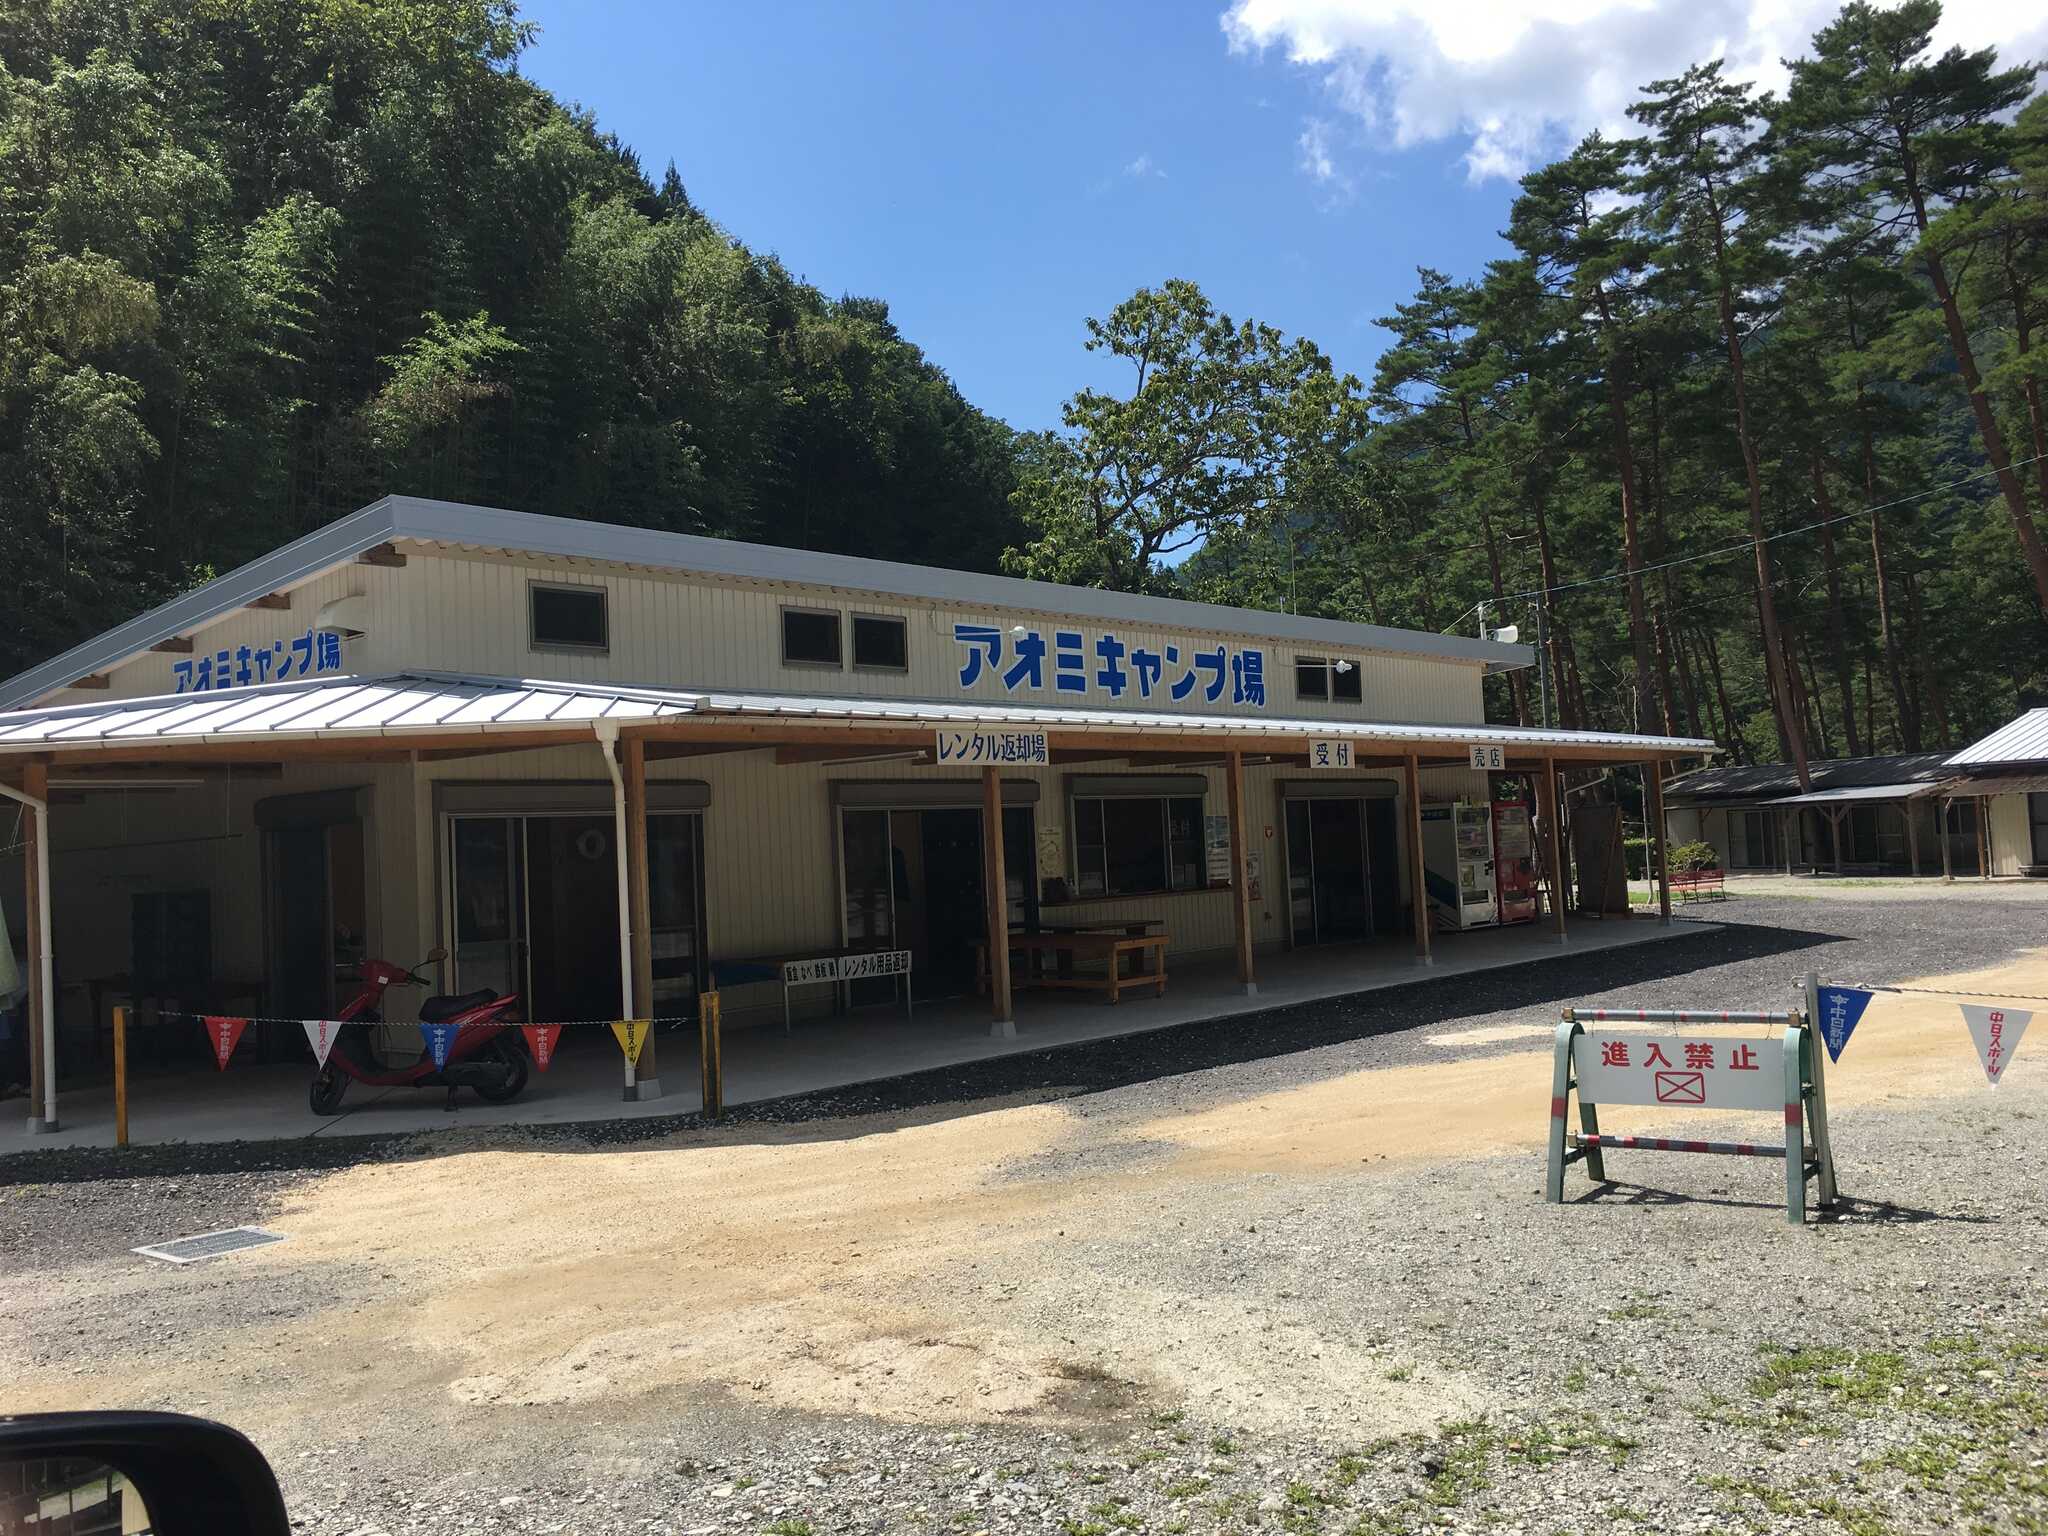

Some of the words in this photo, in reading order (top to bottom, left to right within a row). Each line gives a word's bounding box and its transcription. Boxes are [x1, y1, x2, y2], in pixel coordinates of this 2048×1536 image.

[173, 629, 341, 694] アオミキャンプ場
[953, 624, 1266, 708] アオミキャンプ場
[938, 732, 1046, 763] レンタル返却場
[1315, 743, 1348, 766] 受付
[1473, 747, 1500, 768] 売店
[844, 951, 909, 977] レンタル用品返却
[1601, 1041, 1760, 1071] 進入禁止
[1987, 1011, 2005, 1076] 中日スポーツ
